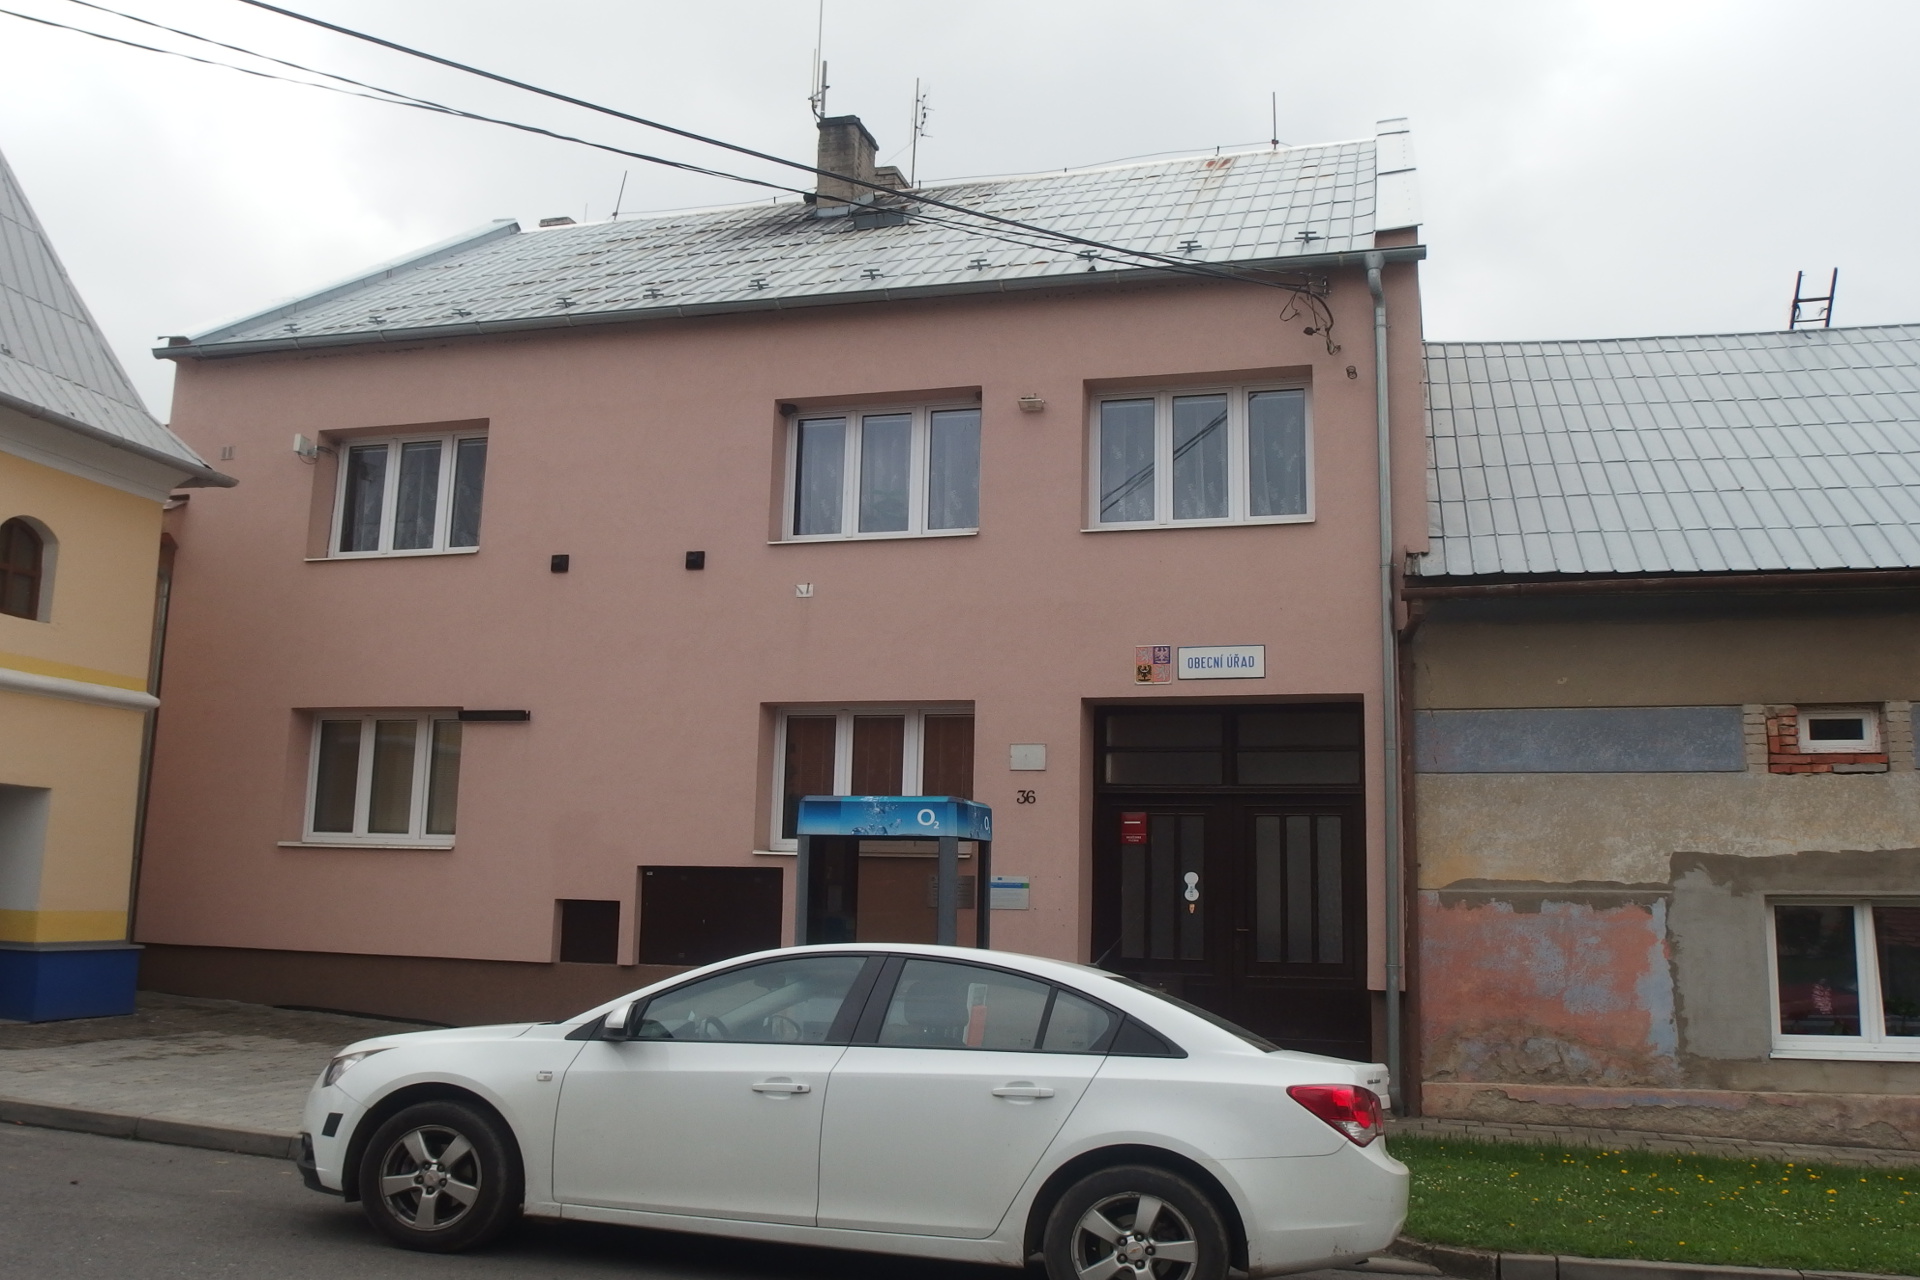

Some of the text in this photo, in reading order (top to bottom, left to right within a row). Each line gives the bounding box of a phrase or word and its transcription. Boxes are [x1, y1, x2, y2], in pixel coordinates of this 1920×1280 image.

[1187, 653, 1255, 669] OBECNÍ ÚŘAD
[1016, 789, 1036, 805] 36
[916, 808, 940, 829] O2
